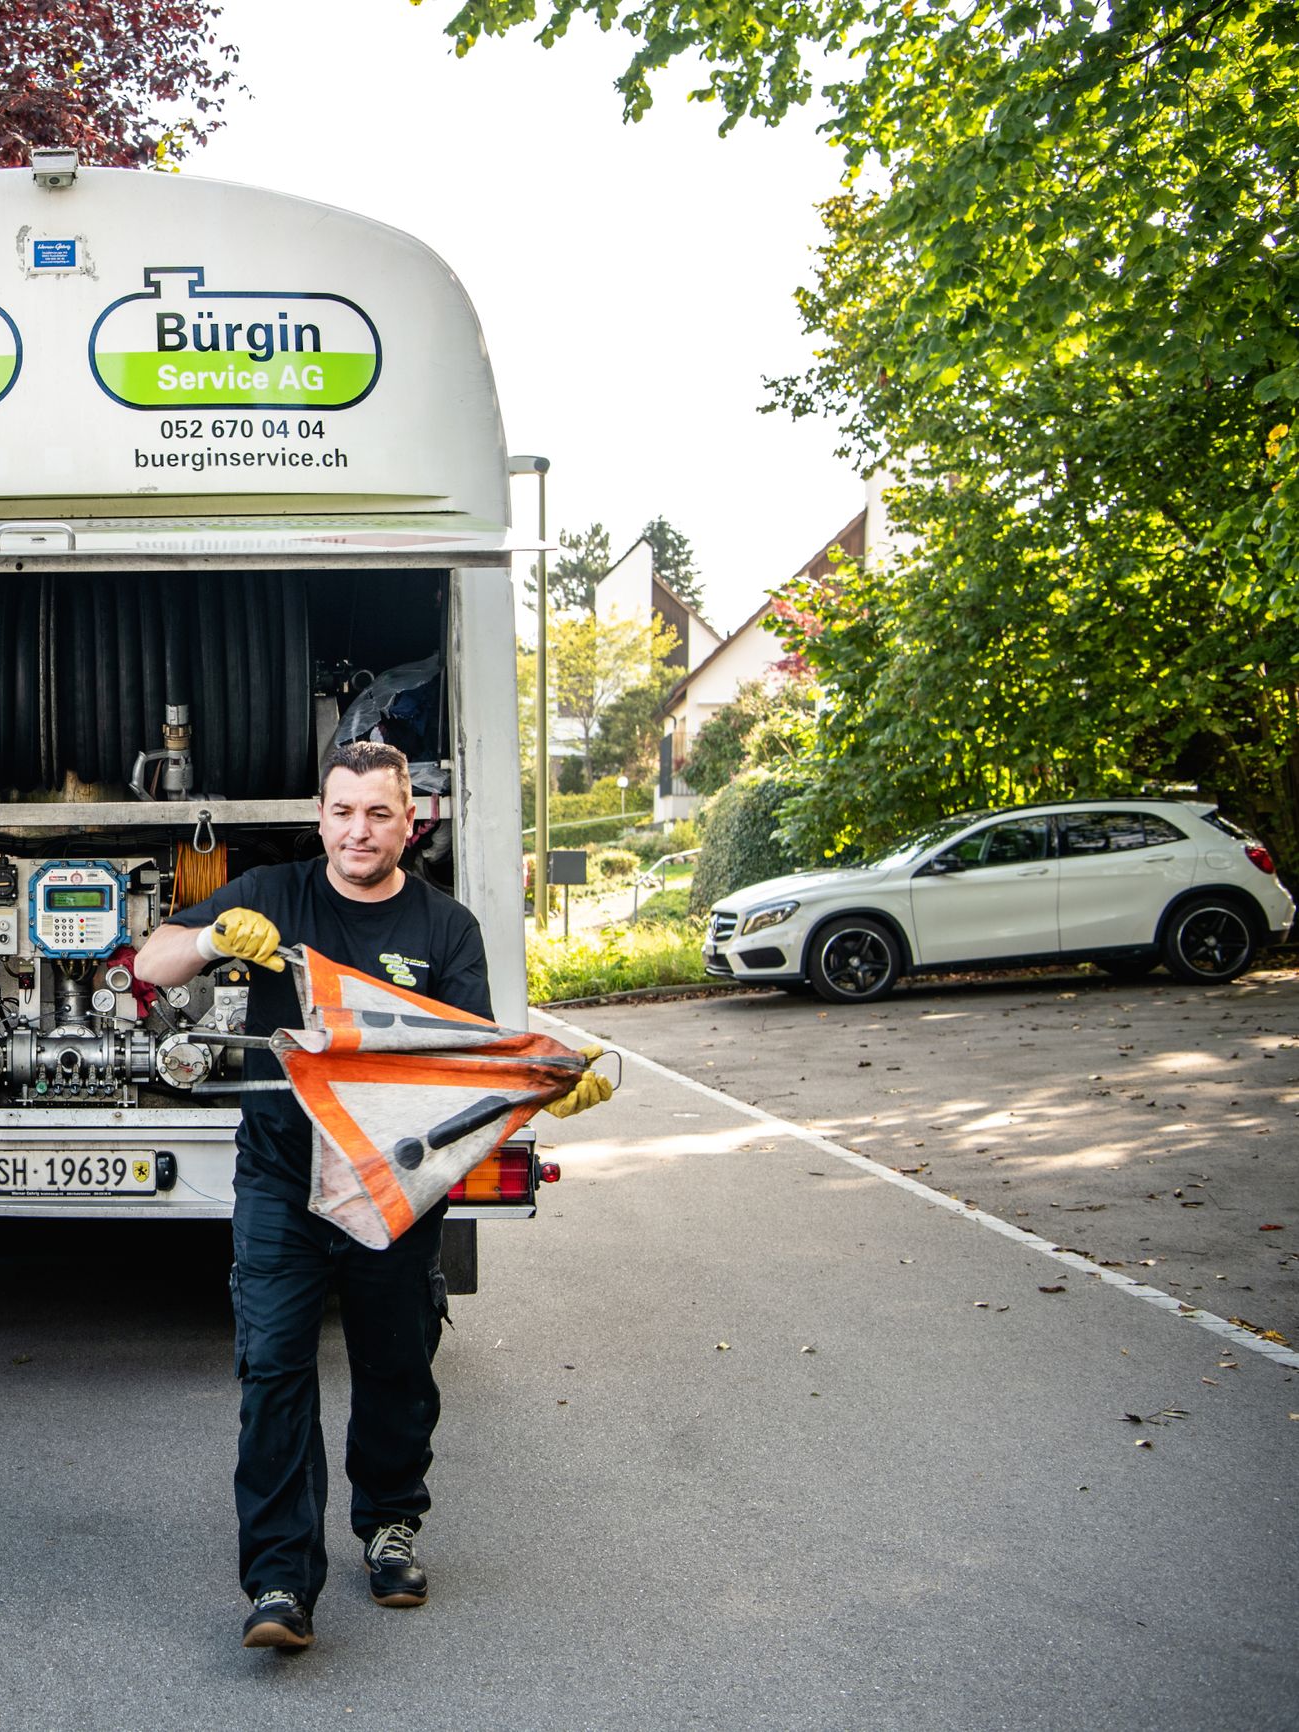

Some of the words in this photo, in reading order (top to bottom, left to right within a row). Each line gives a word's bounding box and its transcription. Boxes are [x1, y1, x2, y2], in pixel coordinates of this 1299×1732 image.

[156, 311, 322, 362] Bürgin
[157, 364, 269, 391] Service
[278, 364, 324, 391] AG
[160, 419, 204, 440] 052
[211, 419, 254, 440] 670
[261, 419, 291, 439] 04
[297, 419, 326, 440] 04
[133, 447, 349, 472] buerginservice.ch
